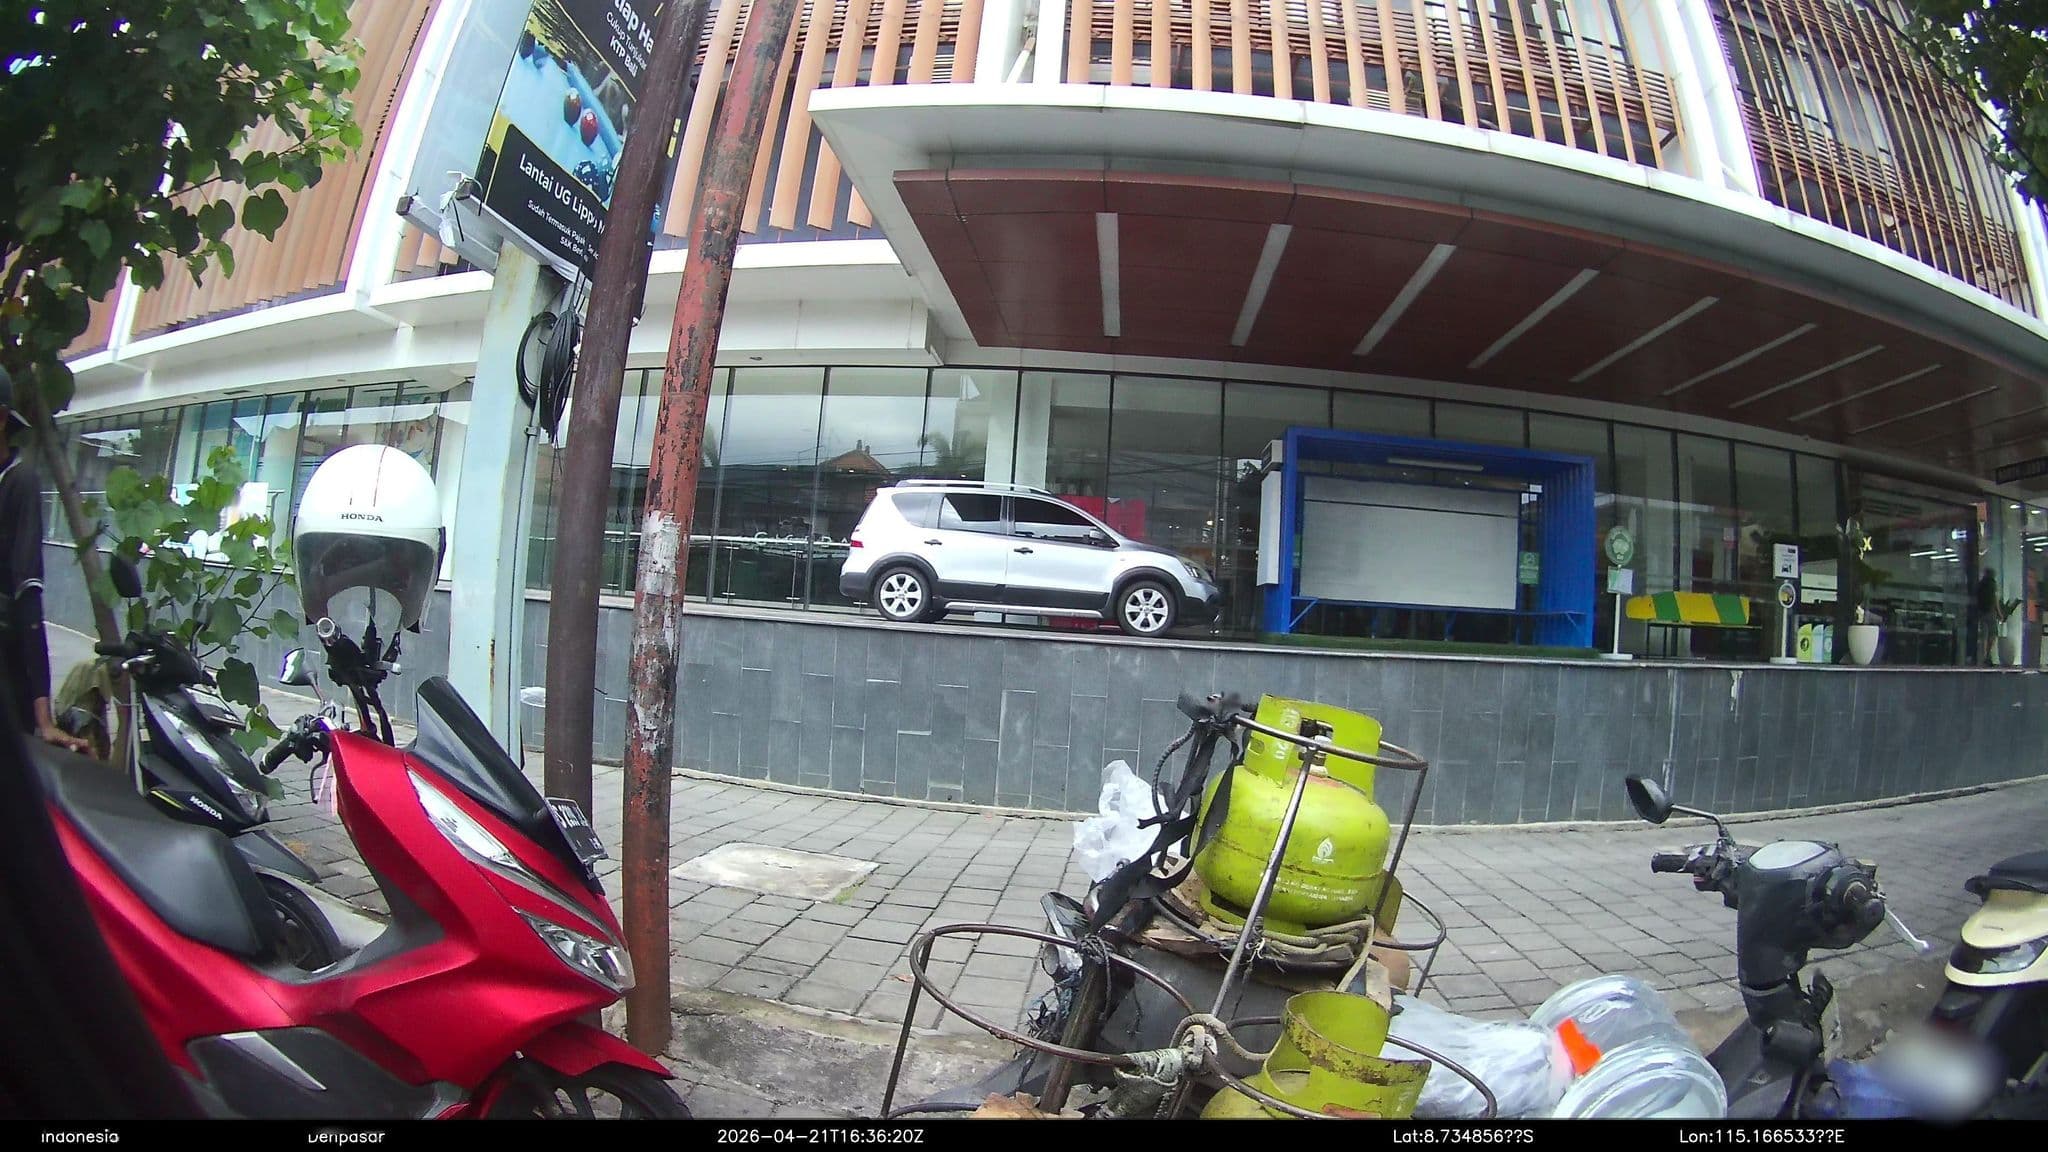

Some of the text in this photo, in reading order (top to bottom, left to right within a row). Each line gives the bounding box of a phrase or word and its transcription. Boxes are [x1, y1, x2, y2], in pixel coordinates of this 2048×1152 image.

[610, 36, 625, 58] KTP
[519, 153, 554, 193] Lantai
[554, 182, 571, 205] UG
[341, 513, 383, 522] HONDA
[190, 796, 223, 820] HONDA
